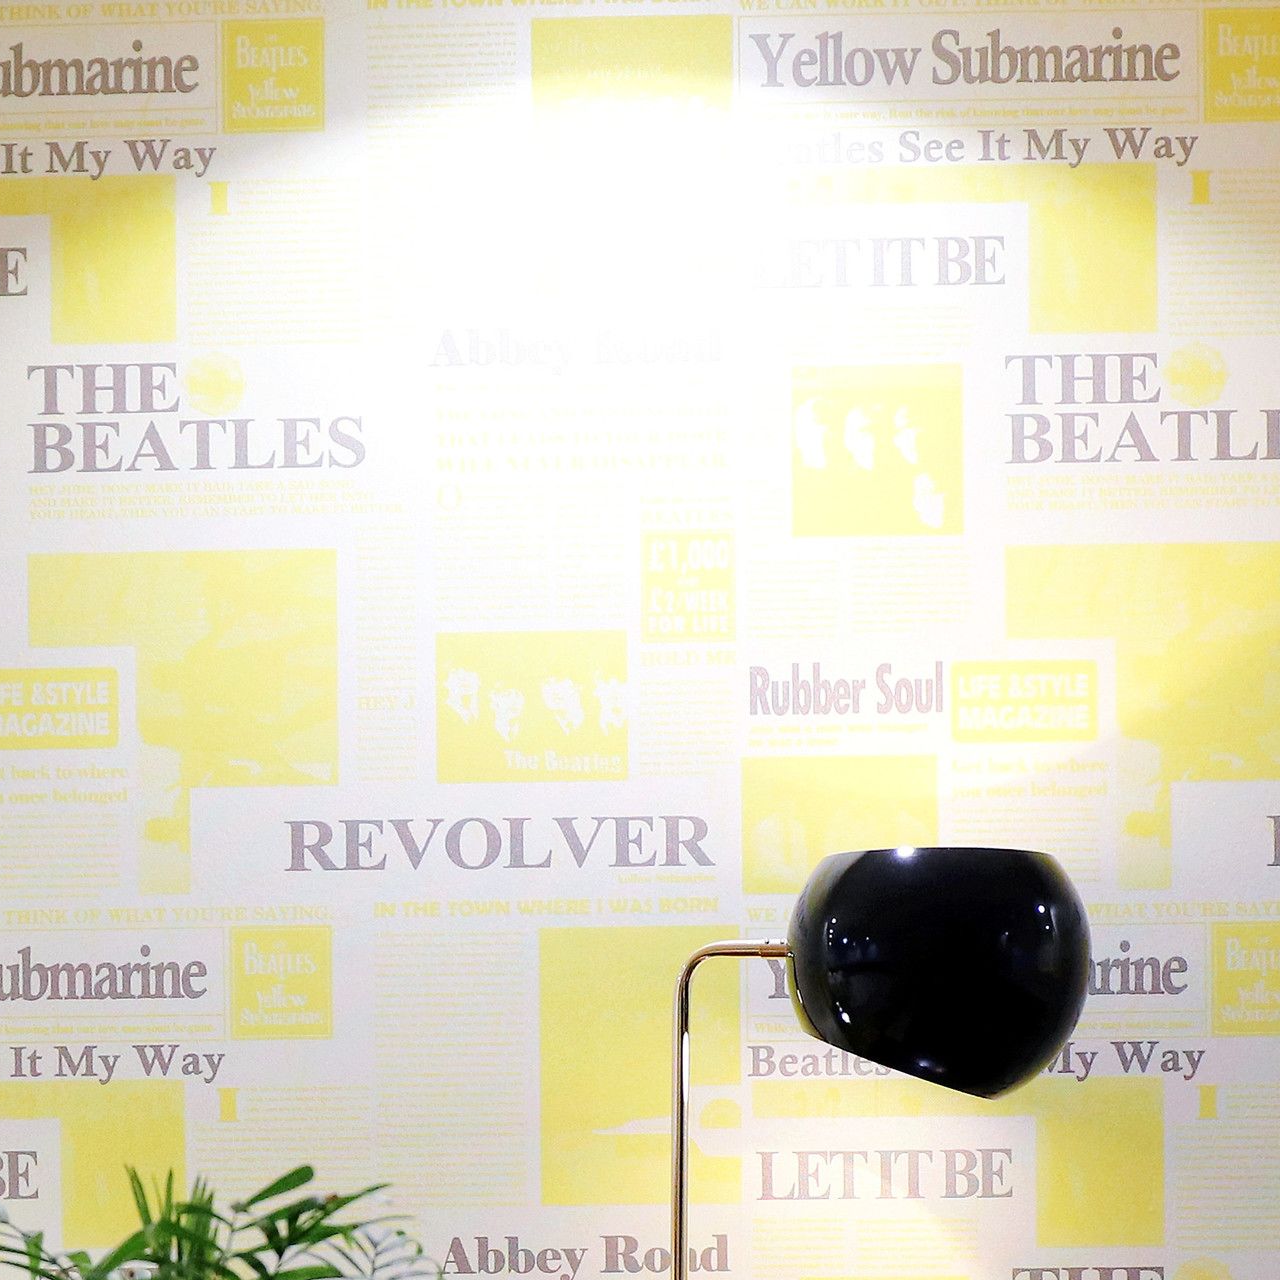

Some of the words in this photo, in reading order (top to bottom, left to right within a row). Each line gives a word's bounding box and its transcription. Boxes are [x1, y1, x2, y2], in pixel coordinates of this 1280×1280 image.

[750, 31, 922, 87] Yellow
[932, 27, 1180, 85] Submarine
[1, 143, 33, 174] It
[45, 141, 111, 181] My
[123, 139, 216, 177] Way
[900, 130, 965, 162] See
[978, 130, 1011, 160] It
[1023, 129, 1091, 168] My
[1103, 127, 1198, 167] Way
[868, 237, 926, 287] IT
[933, 235, 1006, 286] BE
[27, 363, 179, 416] THE
[1005, 353, 1161, 405] THE
[26, 415, 367, 475] BEATLES
[749, 662, 866, 716] Rubber
[875, 660, 944, 714] Soul
[284, 816, 715, 872] REVOLVER
[10, 1046, 42, 1077] It
[54, 1045, 120, 1085] My
[132, 1045, 225, 1084] Way
[1110, 1041, 1205, 1080] Way
[755, 1150, 868, 1201] LET
[875, 1150, 933, 1199] IT
[941, 1148, 1013, 1199] BE
